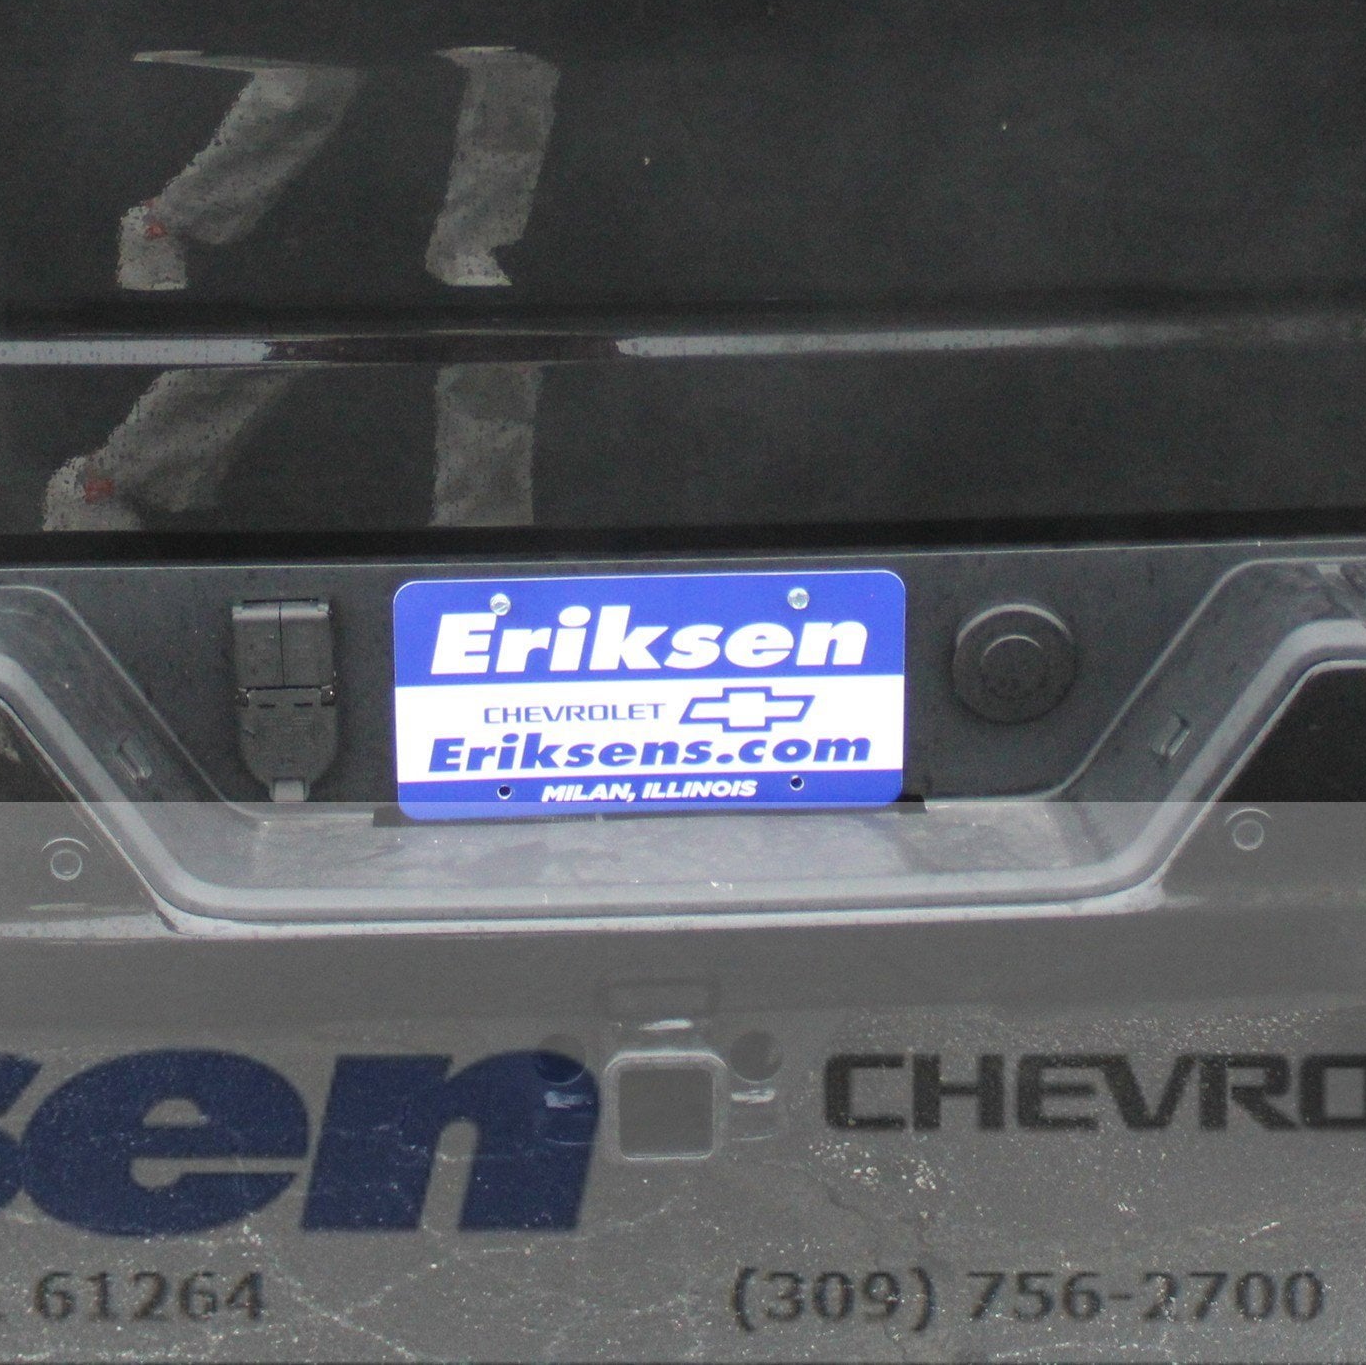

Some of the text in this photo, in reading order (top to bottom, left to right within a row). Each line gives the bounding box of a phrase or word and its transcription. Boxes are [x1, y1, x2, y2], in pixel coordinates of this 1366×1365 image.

[430, 604, 869, 675] Eriksen
[483, 702, 666, 724] CHEVROLET
[428, 732, 872, 773] Eriksens.com
[541, 778, 758, 803] MILAN, ILLINOIS
